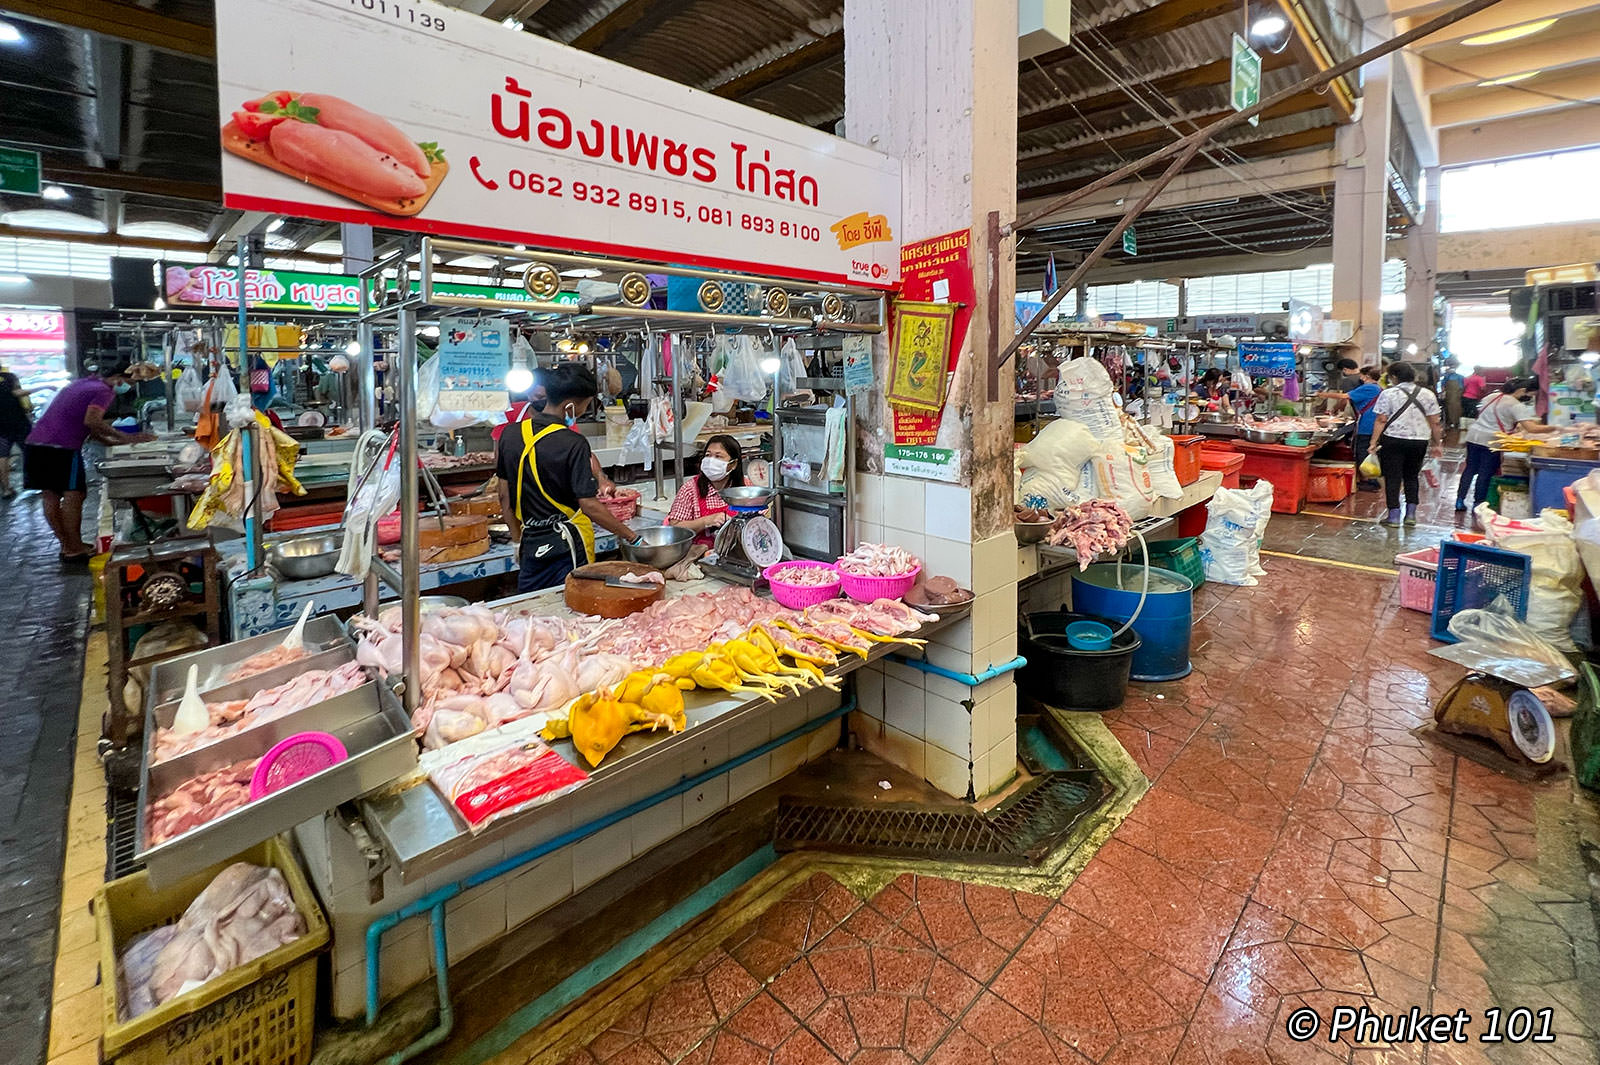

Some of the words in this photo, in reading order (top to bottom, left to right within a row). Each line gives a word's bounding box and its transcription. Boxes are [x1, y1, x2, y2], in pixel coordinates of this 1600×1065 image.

[489, 75, 718, 184] น้องเพชร
[730, 141, 819, 208] ไก่สด
[508, 168, 563, 198] 062
[572, 181, 621, 208] 932
[628, 192, 692, 223] 8915,
[697, 205, 732, 227] 081
[740, 213, 775, 235] 893
[779, 220, 821, 243] 8100
[841, 223, 861, 243] โดย
[851, 259, 870, 273] true
[292, 284, 361, 309] หมูสด
